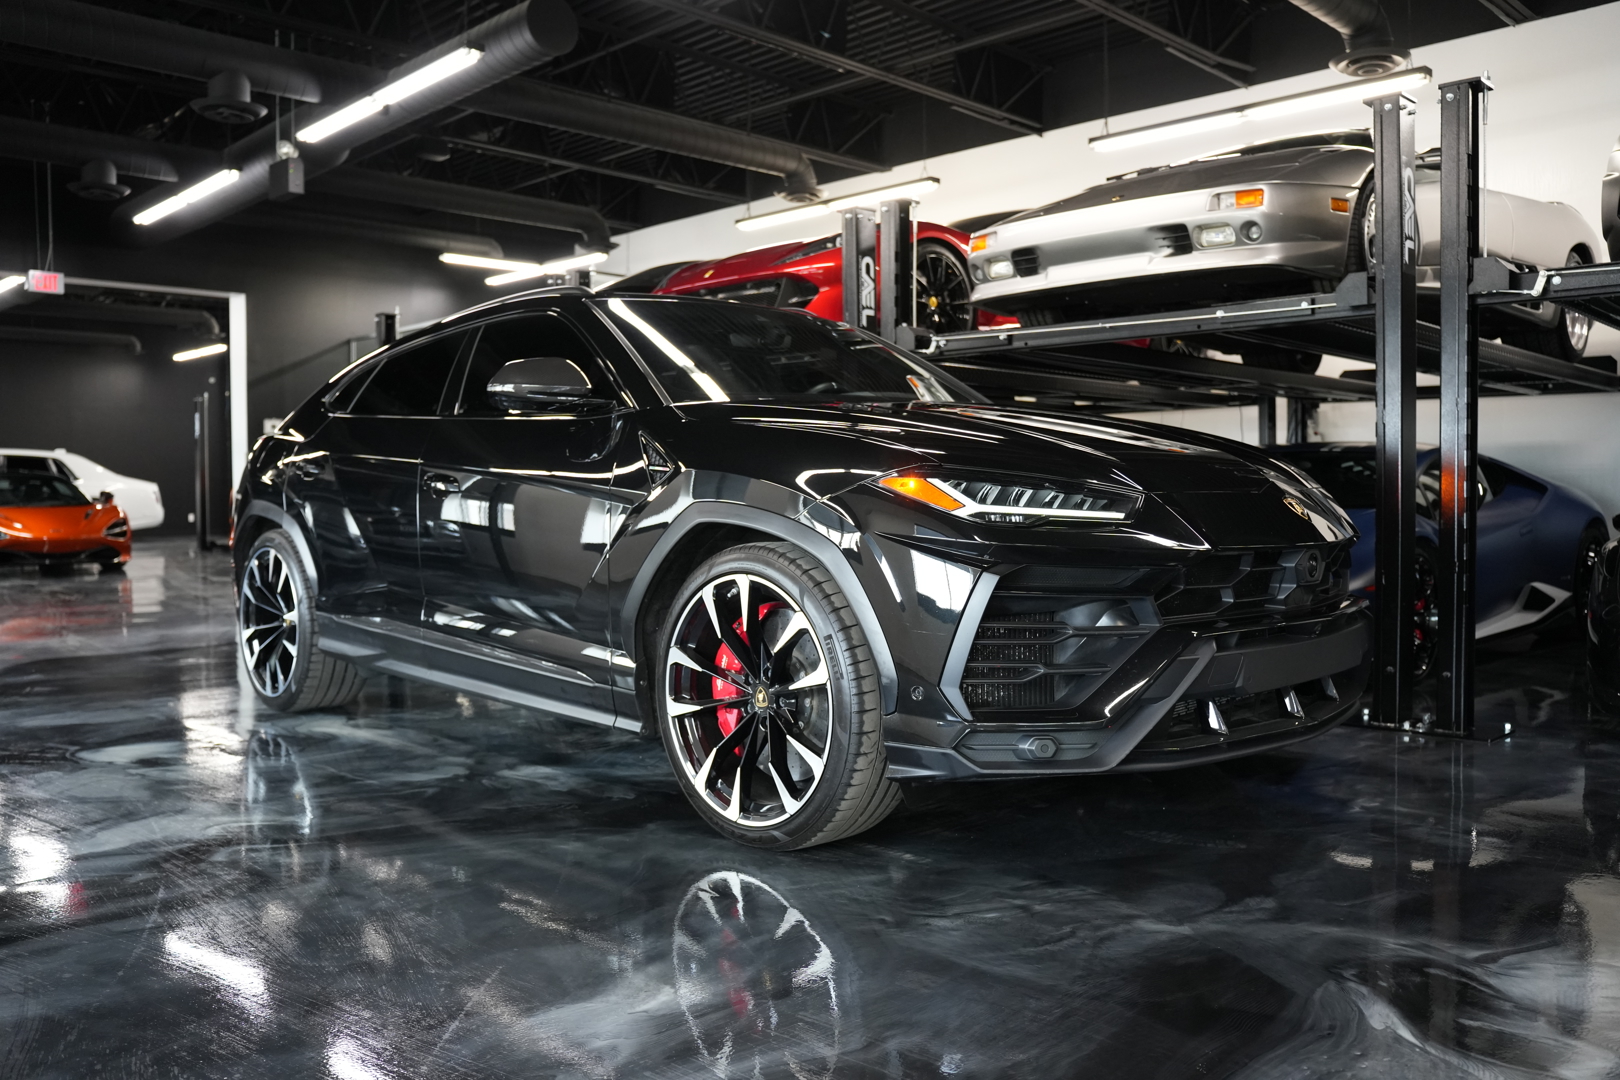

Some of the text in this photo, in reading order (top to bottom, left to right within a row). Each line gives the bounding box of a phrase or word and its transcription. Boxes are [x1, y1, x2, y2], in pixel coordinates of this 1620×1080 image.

[1405, 168, 1415, 264] CAEL
[34, 274, 58, 292] EXIT
[861, 256, 875, 327] CAEL
[823, 633, 844, 681] PIRELLI
